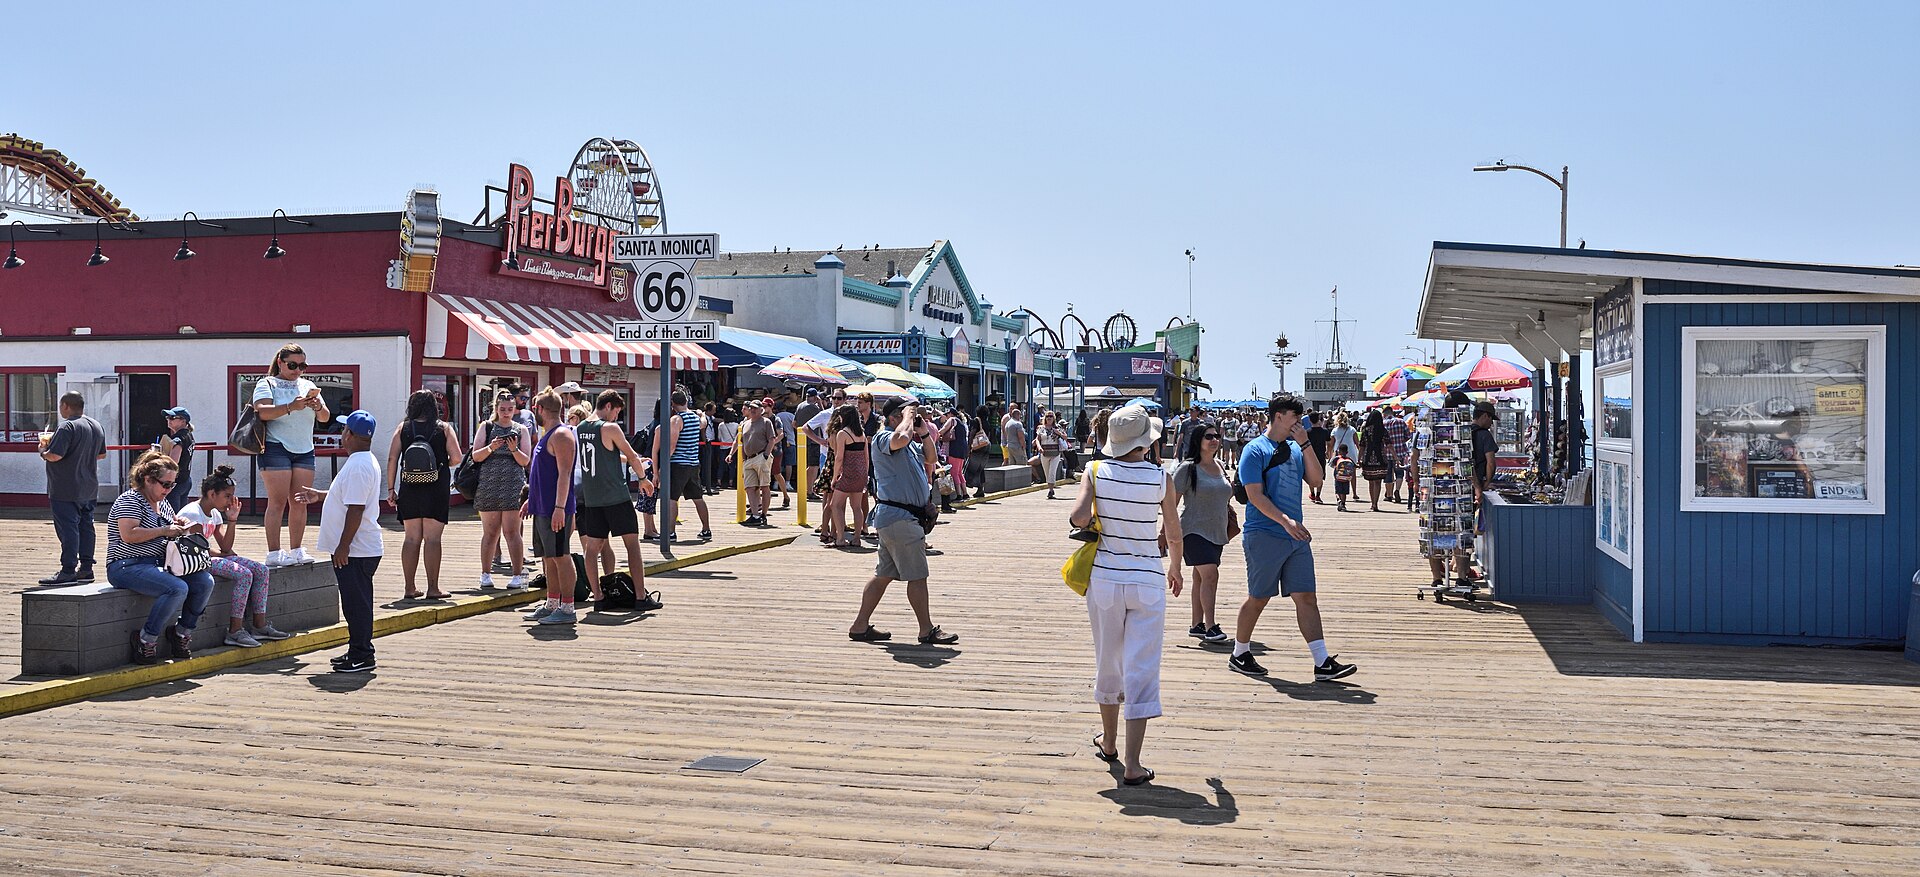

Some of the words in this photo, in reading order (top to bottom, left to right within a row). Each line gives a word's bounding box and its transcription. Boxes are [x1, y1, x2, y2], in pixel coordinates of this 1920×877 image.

[618, 240, 657, 256] SANTA
[661, 239, 712, 256] MONICA
[612, 279, 626, 296] 66
[642, 271, 686, 313] 66
[1597, 301, 1631, 336] OATMAN
[619, 325, 643, 338] End
[646, 325, 658, 338] of
[661, 325, 680, 338] the
[683, 325, 710, 338] Trail
[840, 339, 901, 350] PLAYLAND
[1477, 378, 1521, 388] CHURROS
[1818, 390, 1847, 398] SMILE
[581, 441, 596, 477] 17
[1821, 486, 1844, 495] END
